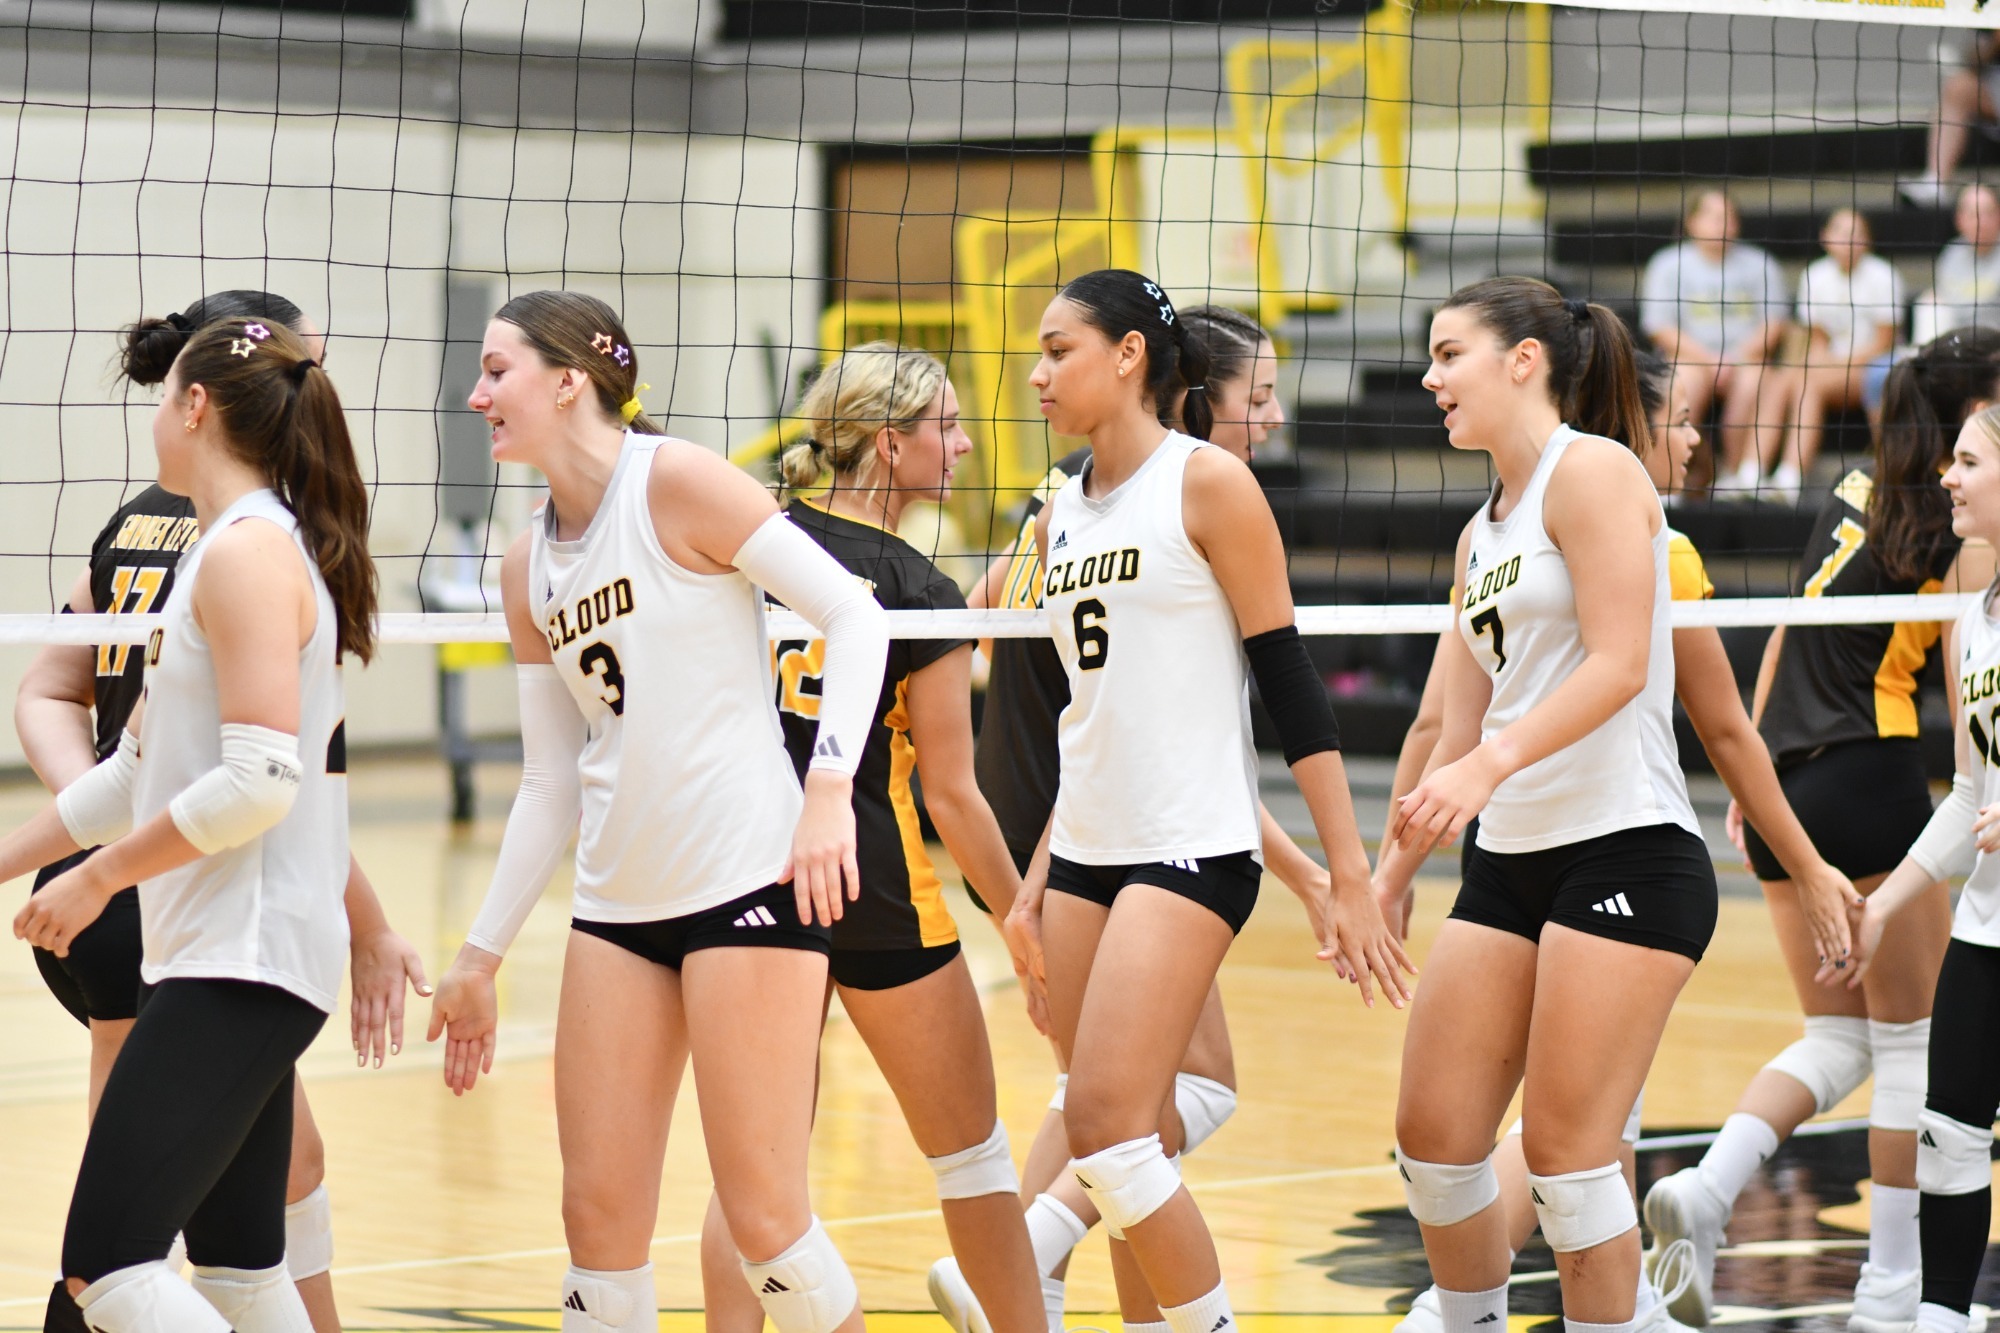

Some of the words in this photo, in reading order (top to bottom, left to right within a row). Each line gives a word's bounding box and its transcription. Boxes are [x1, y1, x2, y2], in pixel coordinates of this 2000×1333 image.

[1045, 547, 1141, 598] CLOUD
[96, 565, 169, 677] 17
[547, 576, 636, 653] CLOUD
[1072, 597, 1109, 672] 6
[1470, 604, 1508, 675] 7
[578, 640, 626, 717] 3
[1961, 664, 2000, 707] CLO
